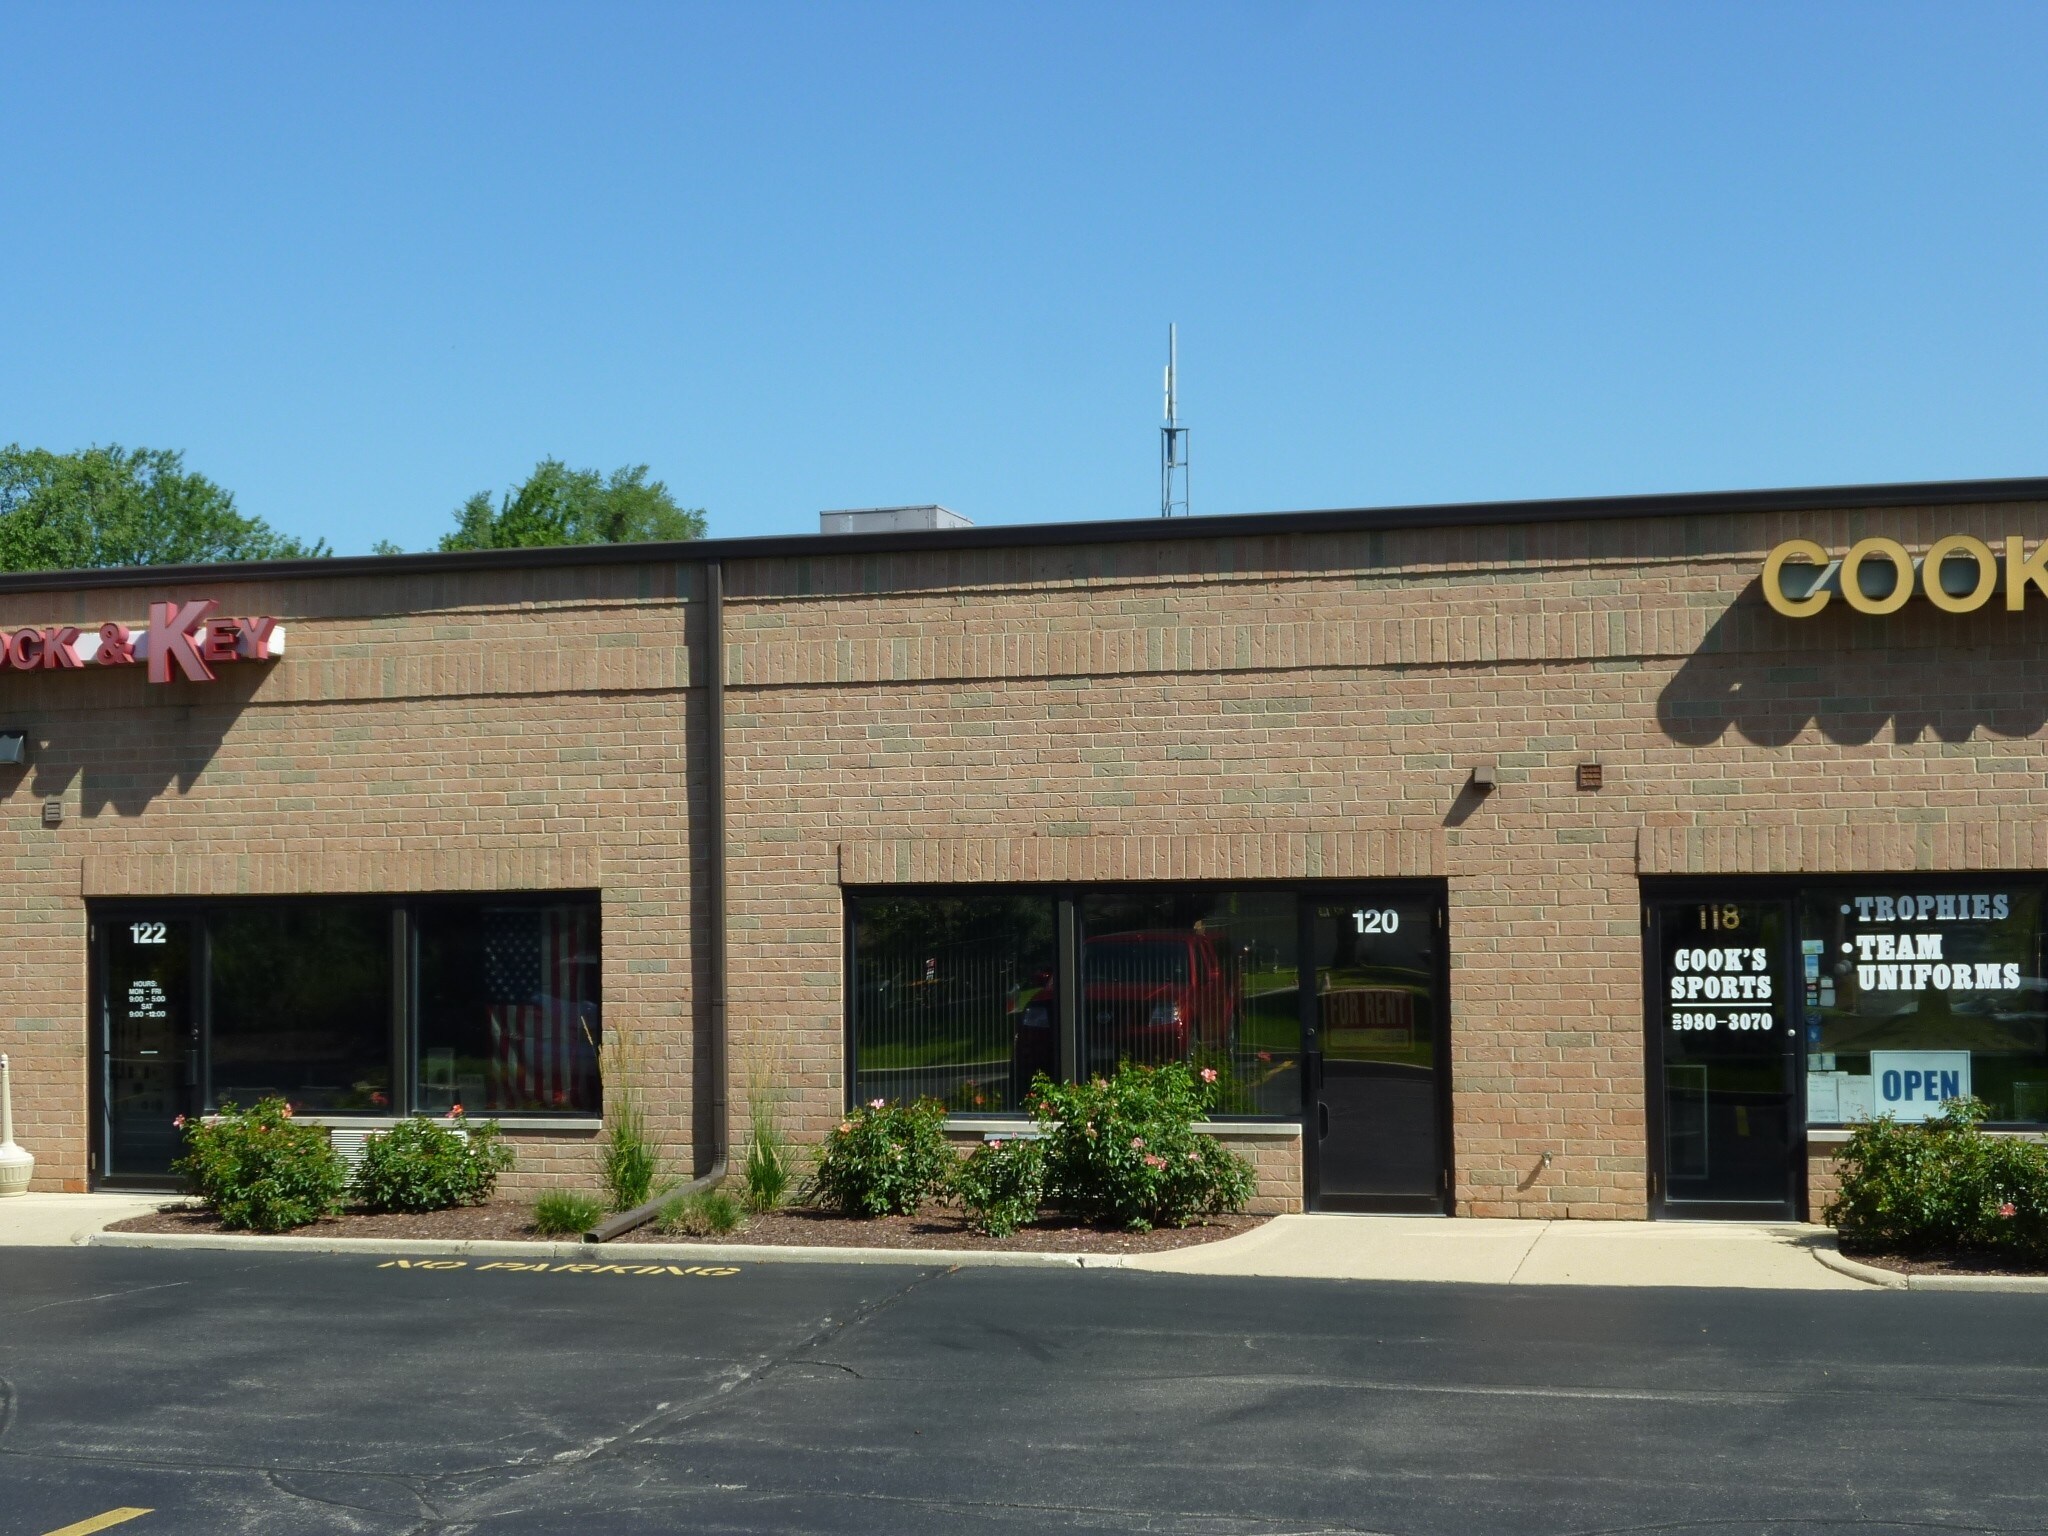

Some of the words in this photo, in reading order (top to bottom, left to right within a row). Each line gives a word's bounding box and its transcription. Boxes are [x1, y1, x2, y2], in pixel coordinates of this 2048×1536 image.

[0, 627, 84, 671] CK
[97, 622, 136, 666] &
[1352, 908, 1400, 935] 120
[1699, 903, 1741, 931] 118
[1855, 894, 2010, 922] TROPHIES
[129, 922, 166, 944] 122
[1674, 947, 1768, 972] COOK'S
[1855, 934, 1944, 961] TEAM
[1671, 975, 1773, 1000] SPORTS
[1856, 963, 2021, 991] UNIFORMS
[1330, 992, 1360, 1025] FOR
[1364, 992, 1406, 1025] RENT
[1682, 1012, 1773, 1031] 980-3070
[1882, 1069, 1960, 1102] OPEN
[376, 1259, 468, 1270] NO
[474, 1261, 742, 1276] PARKING
